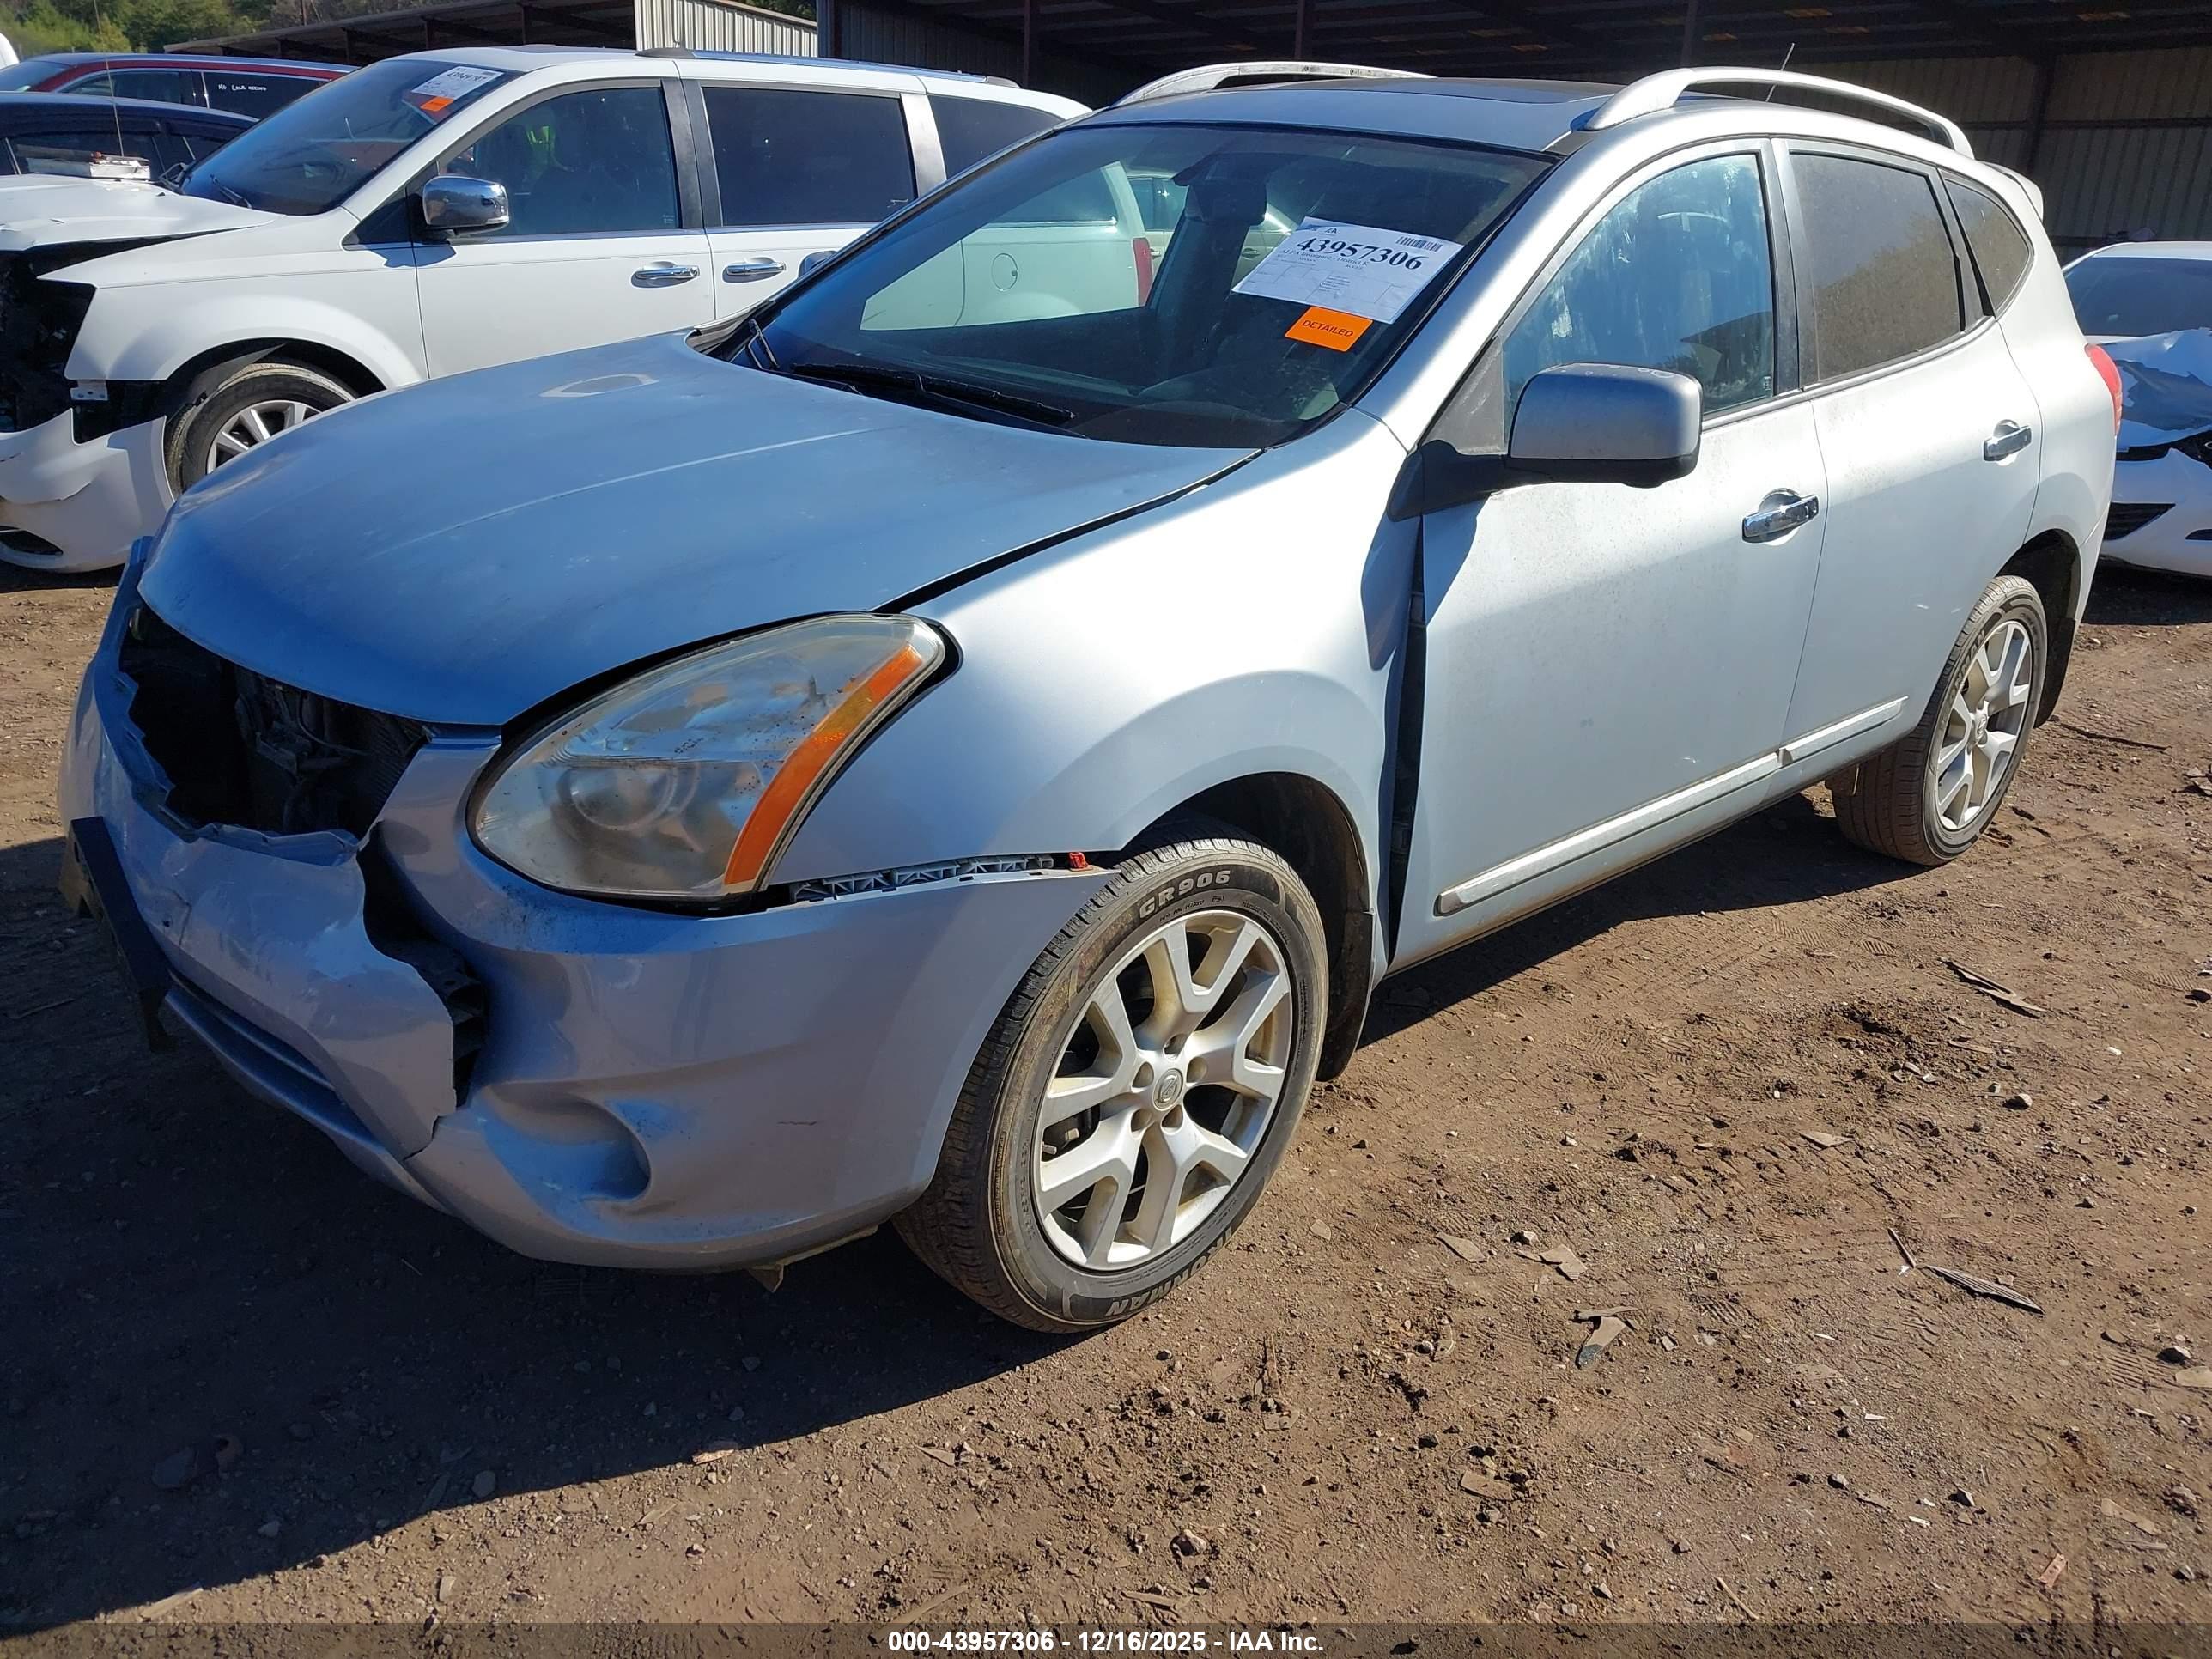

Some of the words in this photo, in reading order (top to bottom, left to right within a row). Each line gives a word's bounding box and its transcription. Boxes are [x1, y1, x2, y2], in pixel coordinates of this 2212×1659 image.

[1297, 237, 1429, 270] 43957306
[1302, 319, 1354, 337] DETAILED
[1139, 870, 1231, 919] GR906
[1105, 1226, 1233, 1316] IRONMAN
